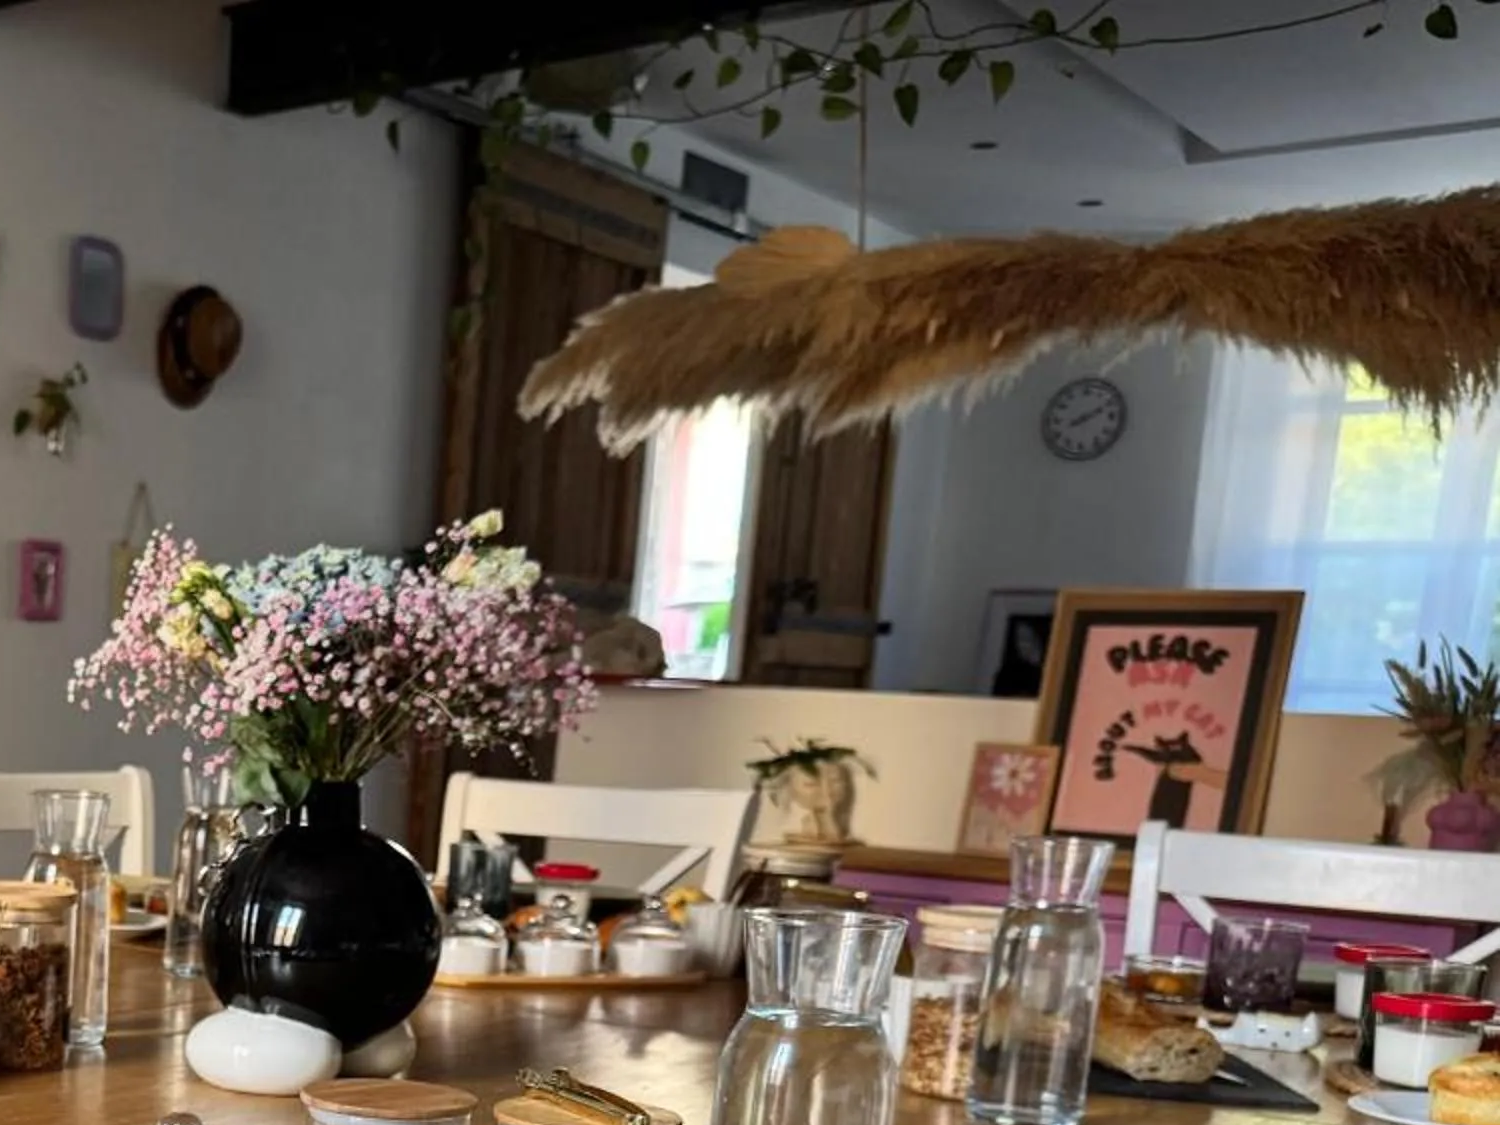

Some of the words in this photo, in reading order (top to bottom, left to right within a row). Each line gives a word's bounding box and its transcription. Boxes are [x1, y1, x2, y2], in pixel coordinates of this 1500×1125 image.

[1106, 634, 1230, 674] PLEASE
[1092, 710, 1136, 781] ABOUT
[1143, 699, 1181, 721] MY
[1183, 703, 1227, 739] CAT
